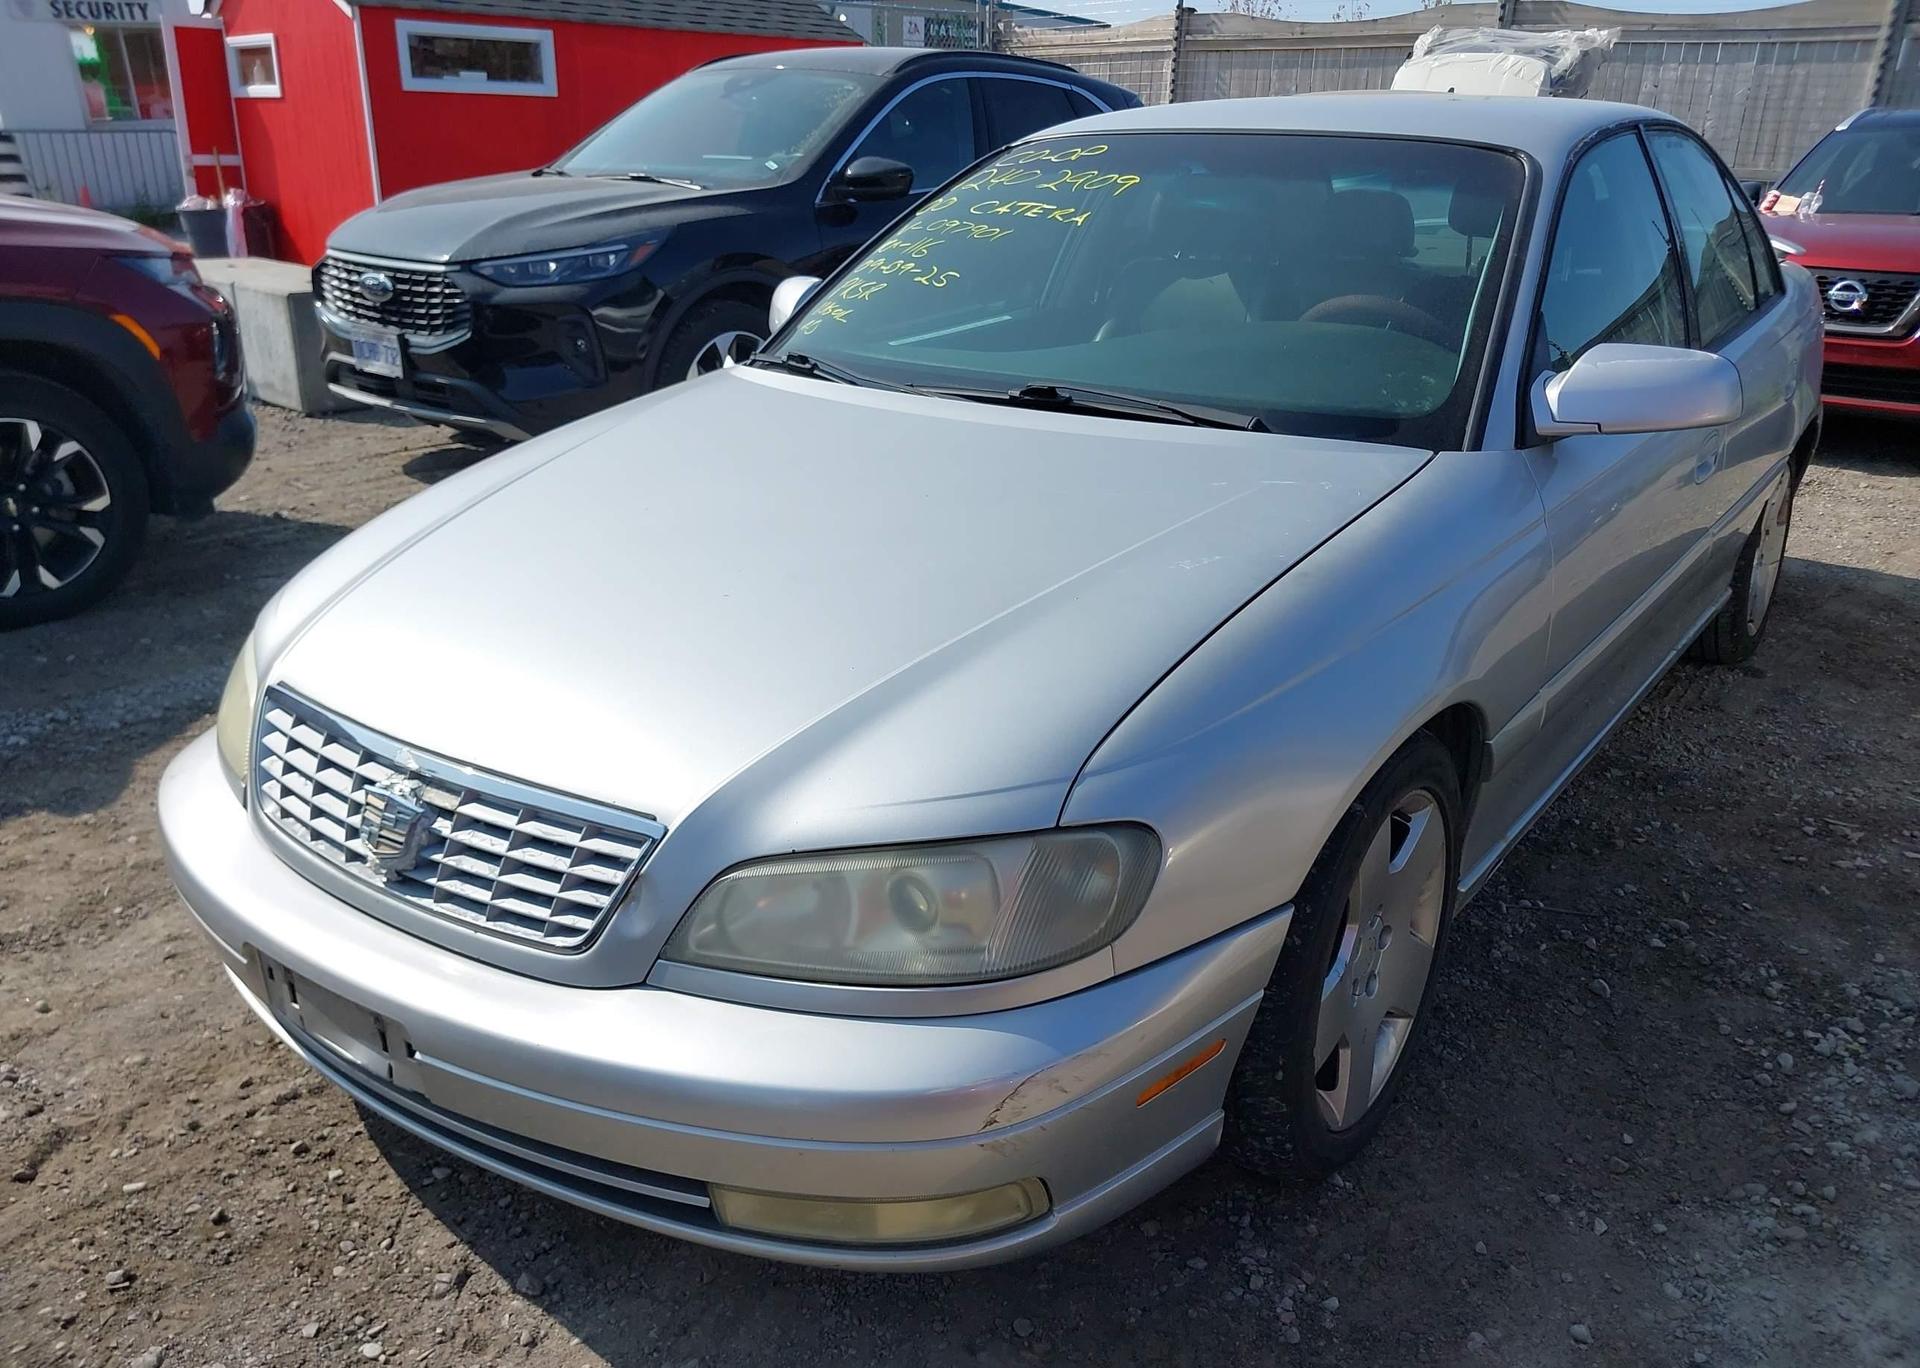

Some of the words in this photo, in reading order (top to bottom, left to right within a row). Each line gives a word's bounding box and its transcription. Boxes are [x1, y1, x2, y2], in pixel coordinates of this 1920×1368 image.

[49, 0, 149, 21] SECURITY
[995, 144, 1109, 167] CO-OP
[1035, 169, 1141, 197] 2909
[970, 200, 1092, 227] CATERA
